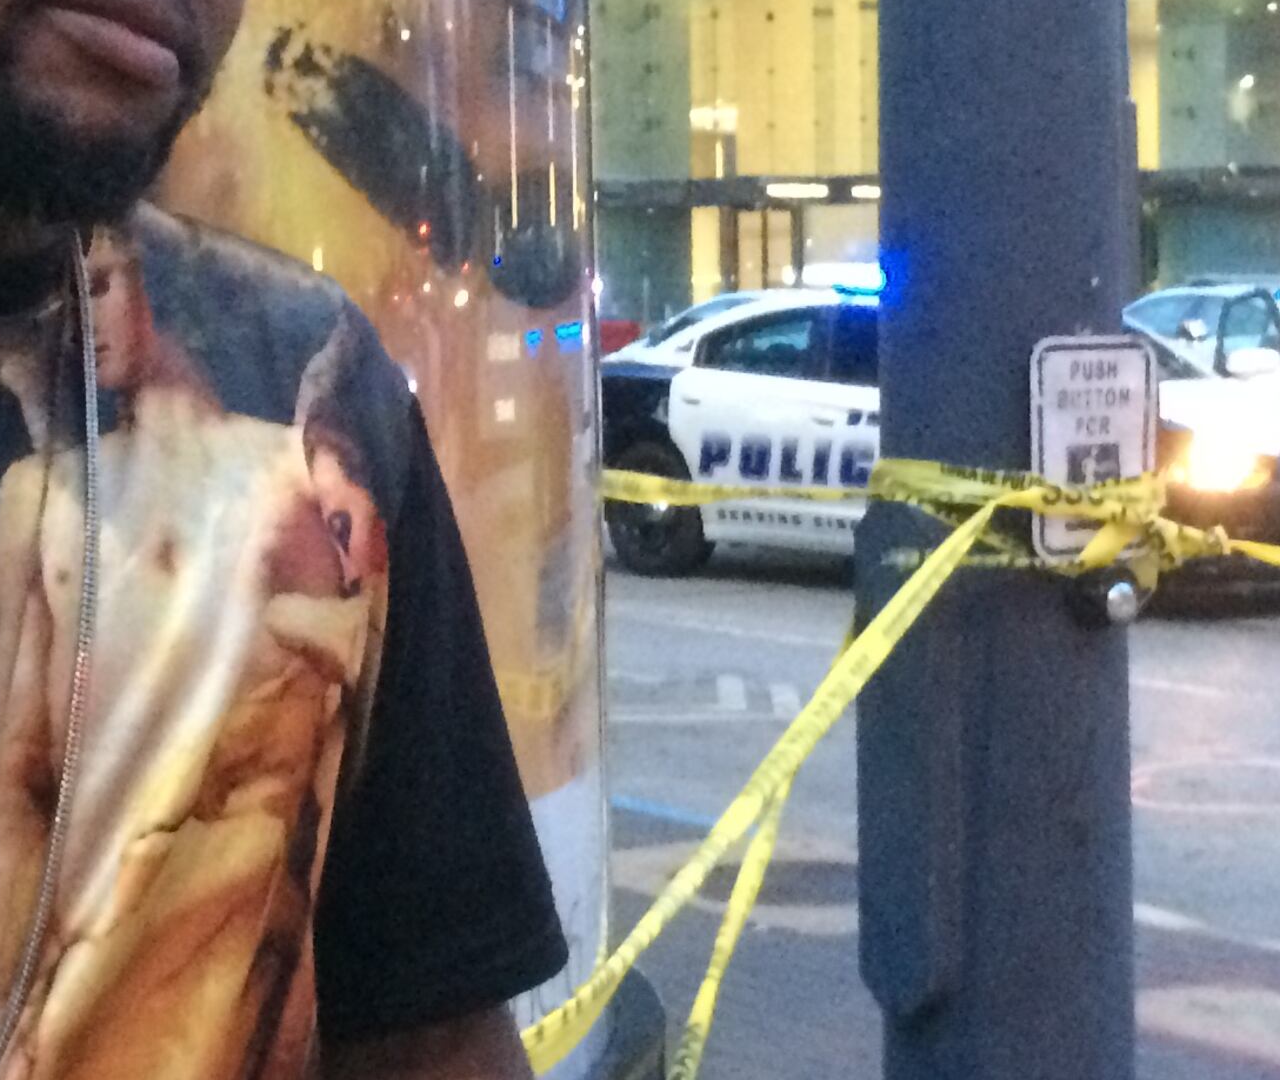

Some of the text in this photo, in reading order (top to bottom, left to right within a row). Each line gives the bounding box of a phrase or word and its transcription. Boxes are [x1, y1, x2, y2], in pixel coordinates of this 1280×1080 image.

[1070, 359, 1118, 381] PUSH
[1057, 387, 1130, 410] BUTTON
[1076, 416, 1110, 436] FOR
[699, 431, 874, 488] POLIC
